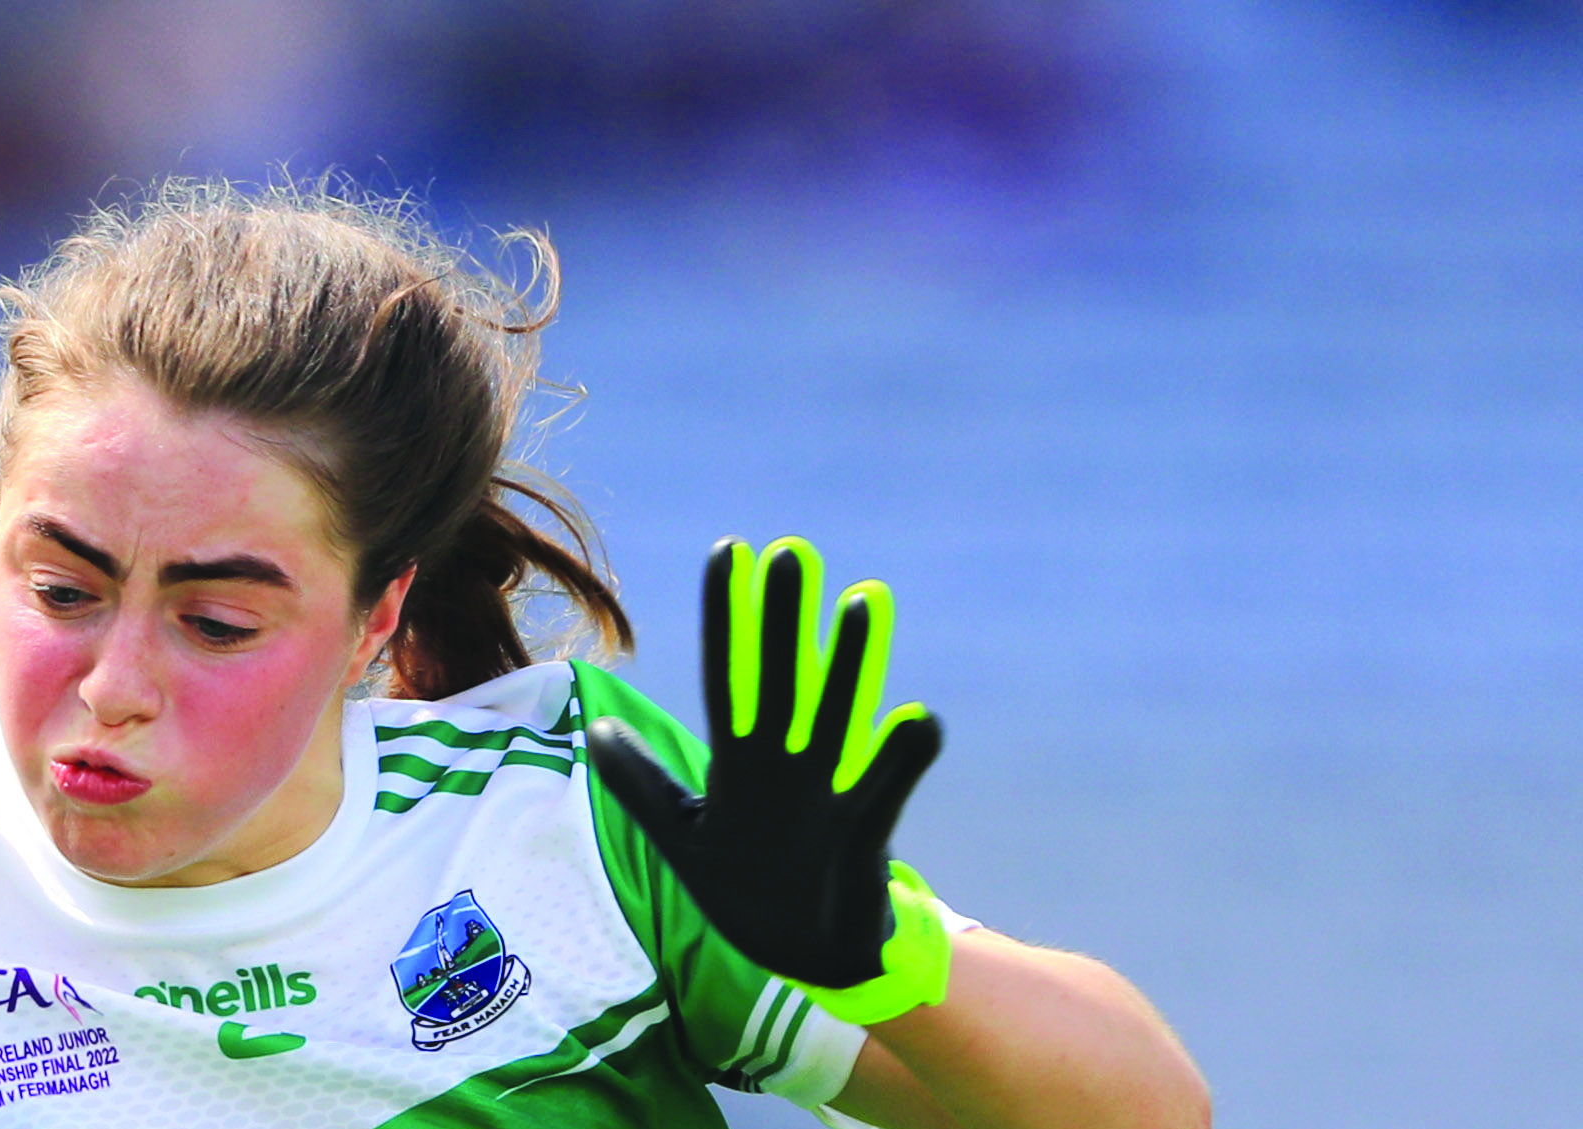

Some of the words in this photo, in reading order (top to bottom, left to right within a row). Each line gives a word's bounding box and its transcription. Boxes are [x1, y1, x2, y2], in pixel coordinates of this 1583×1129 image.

[57, 1026, 110, 1053] JUNIOR
[43, 1057, 86, 1076] FINAL
[86, 1046, 120, 1068] 2022
[8, 1091, 16, 1103] v
[19, 1070, 111, 1100] FERMANAGH
